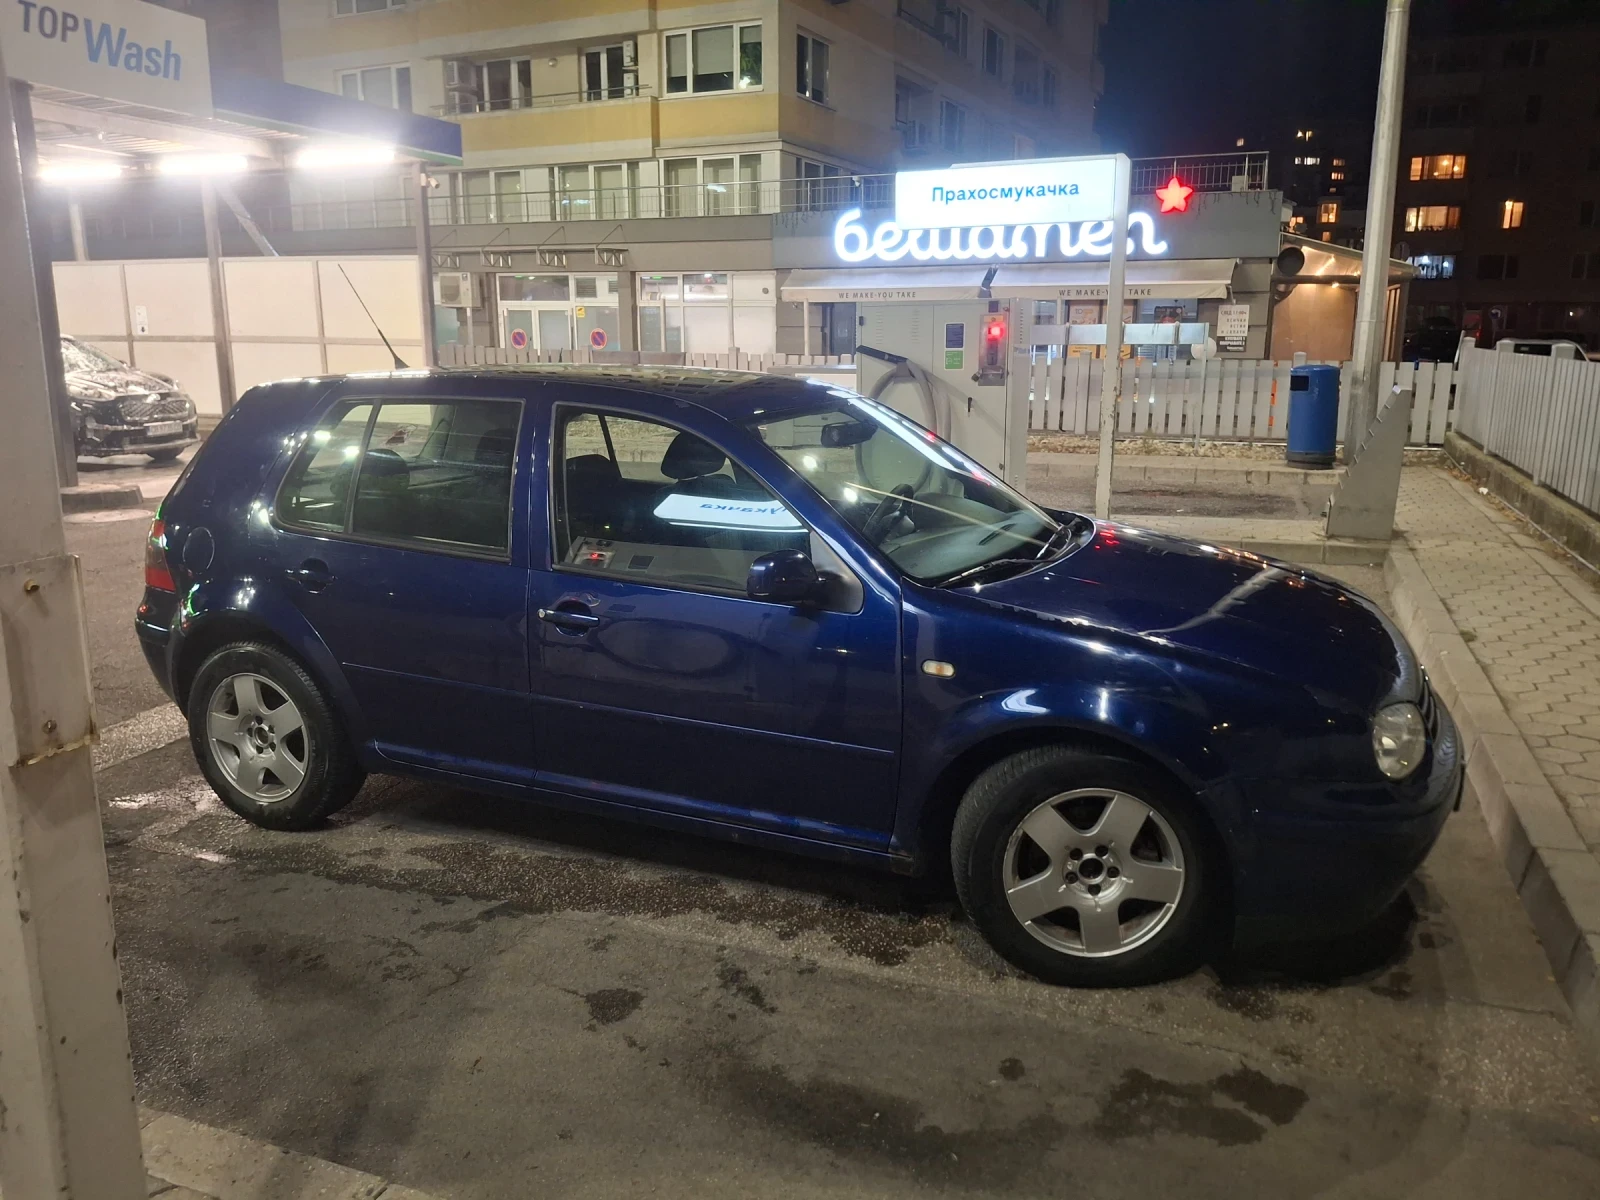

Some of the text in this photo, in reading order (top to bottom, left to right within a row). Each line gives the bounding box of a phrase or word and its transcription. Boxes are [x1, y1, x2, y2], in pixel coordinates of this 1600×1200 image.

[18, 0, 182, 81] TOP Wash
[932, 183, 1080, 206] Прахосмукачка
[1075, 288, 1109, 296] MAKE-Y
[1128, 288, 1152, 296] TAKE
